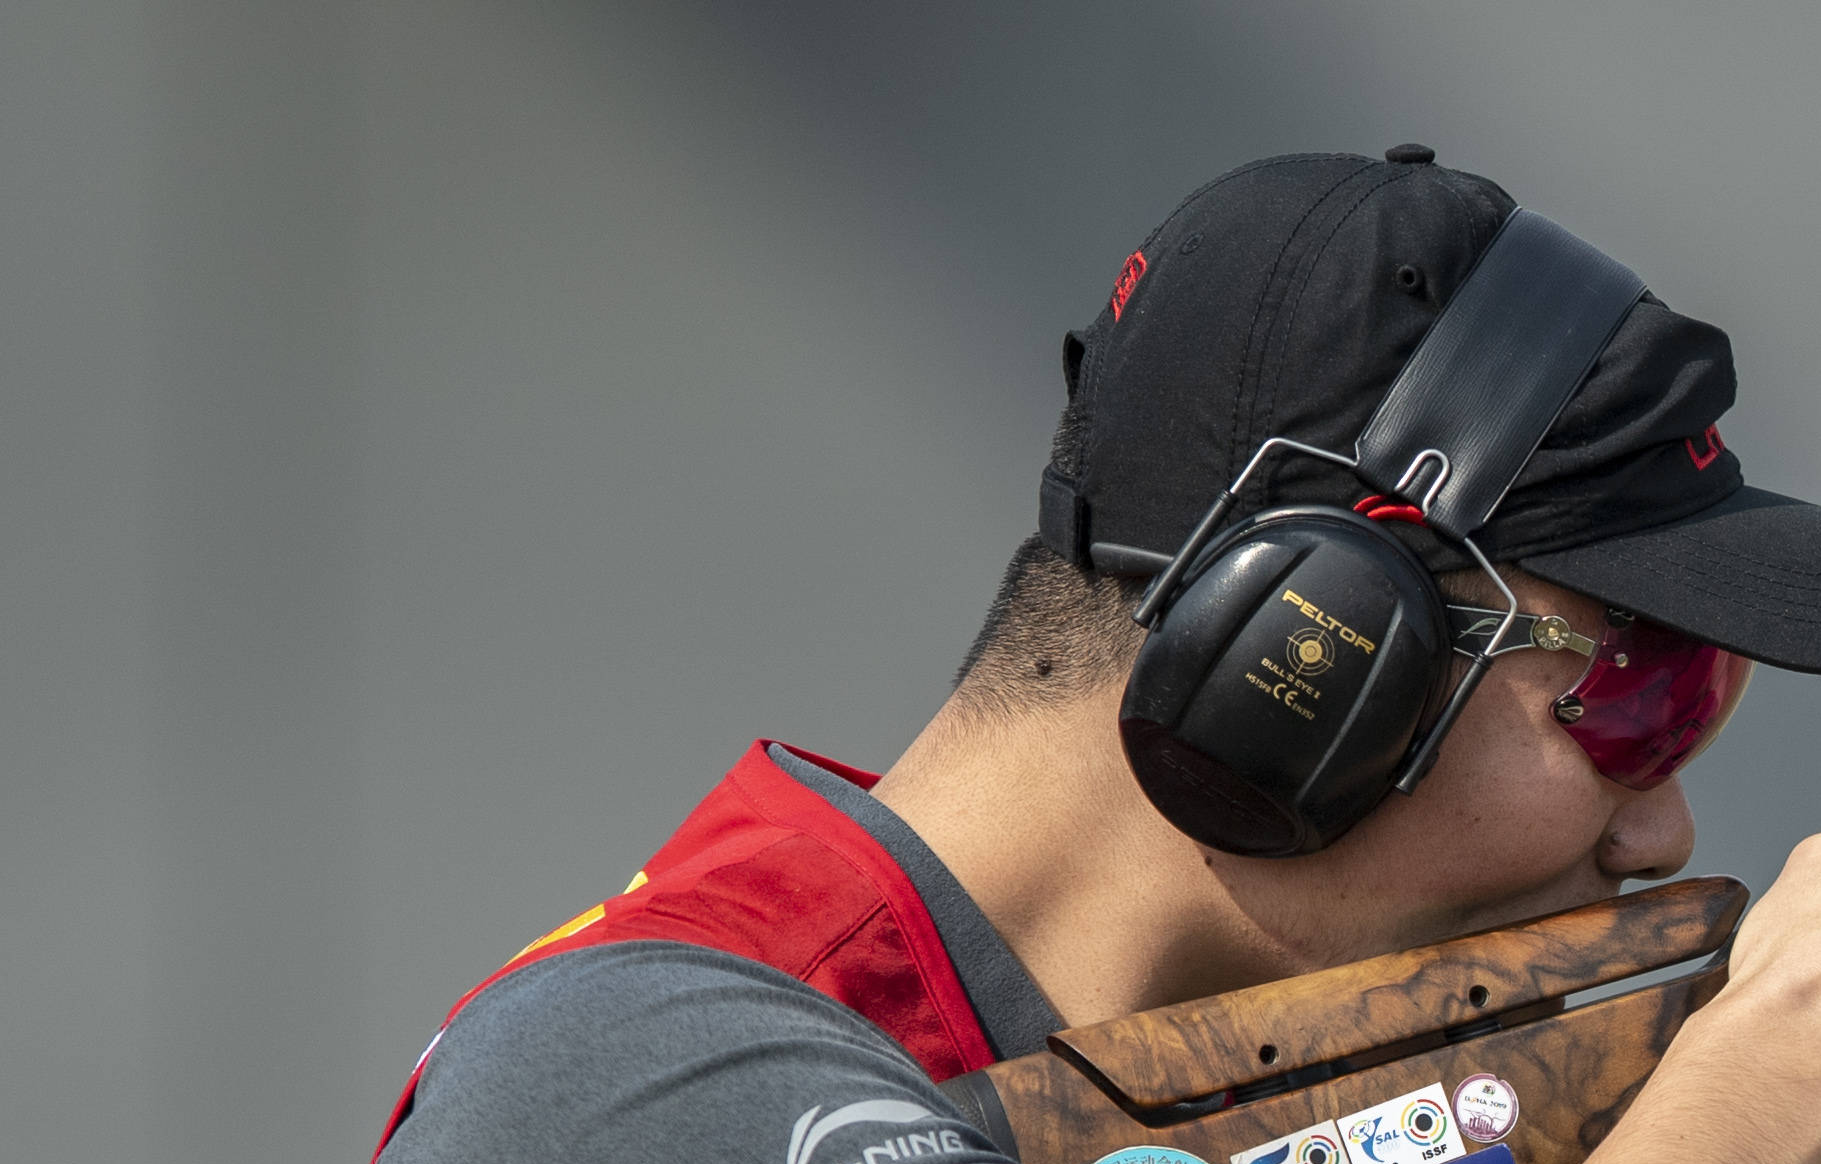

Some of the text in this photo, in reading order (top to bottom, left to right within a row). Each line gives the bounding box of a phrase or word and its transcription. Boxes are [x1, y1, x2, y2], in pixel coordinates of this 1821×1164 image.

[1281, 588, 1376, 655] PELTOR
[1295, 678, 1315, 695] EYE
[1422, 1144, 1448, 1161] ISSF
